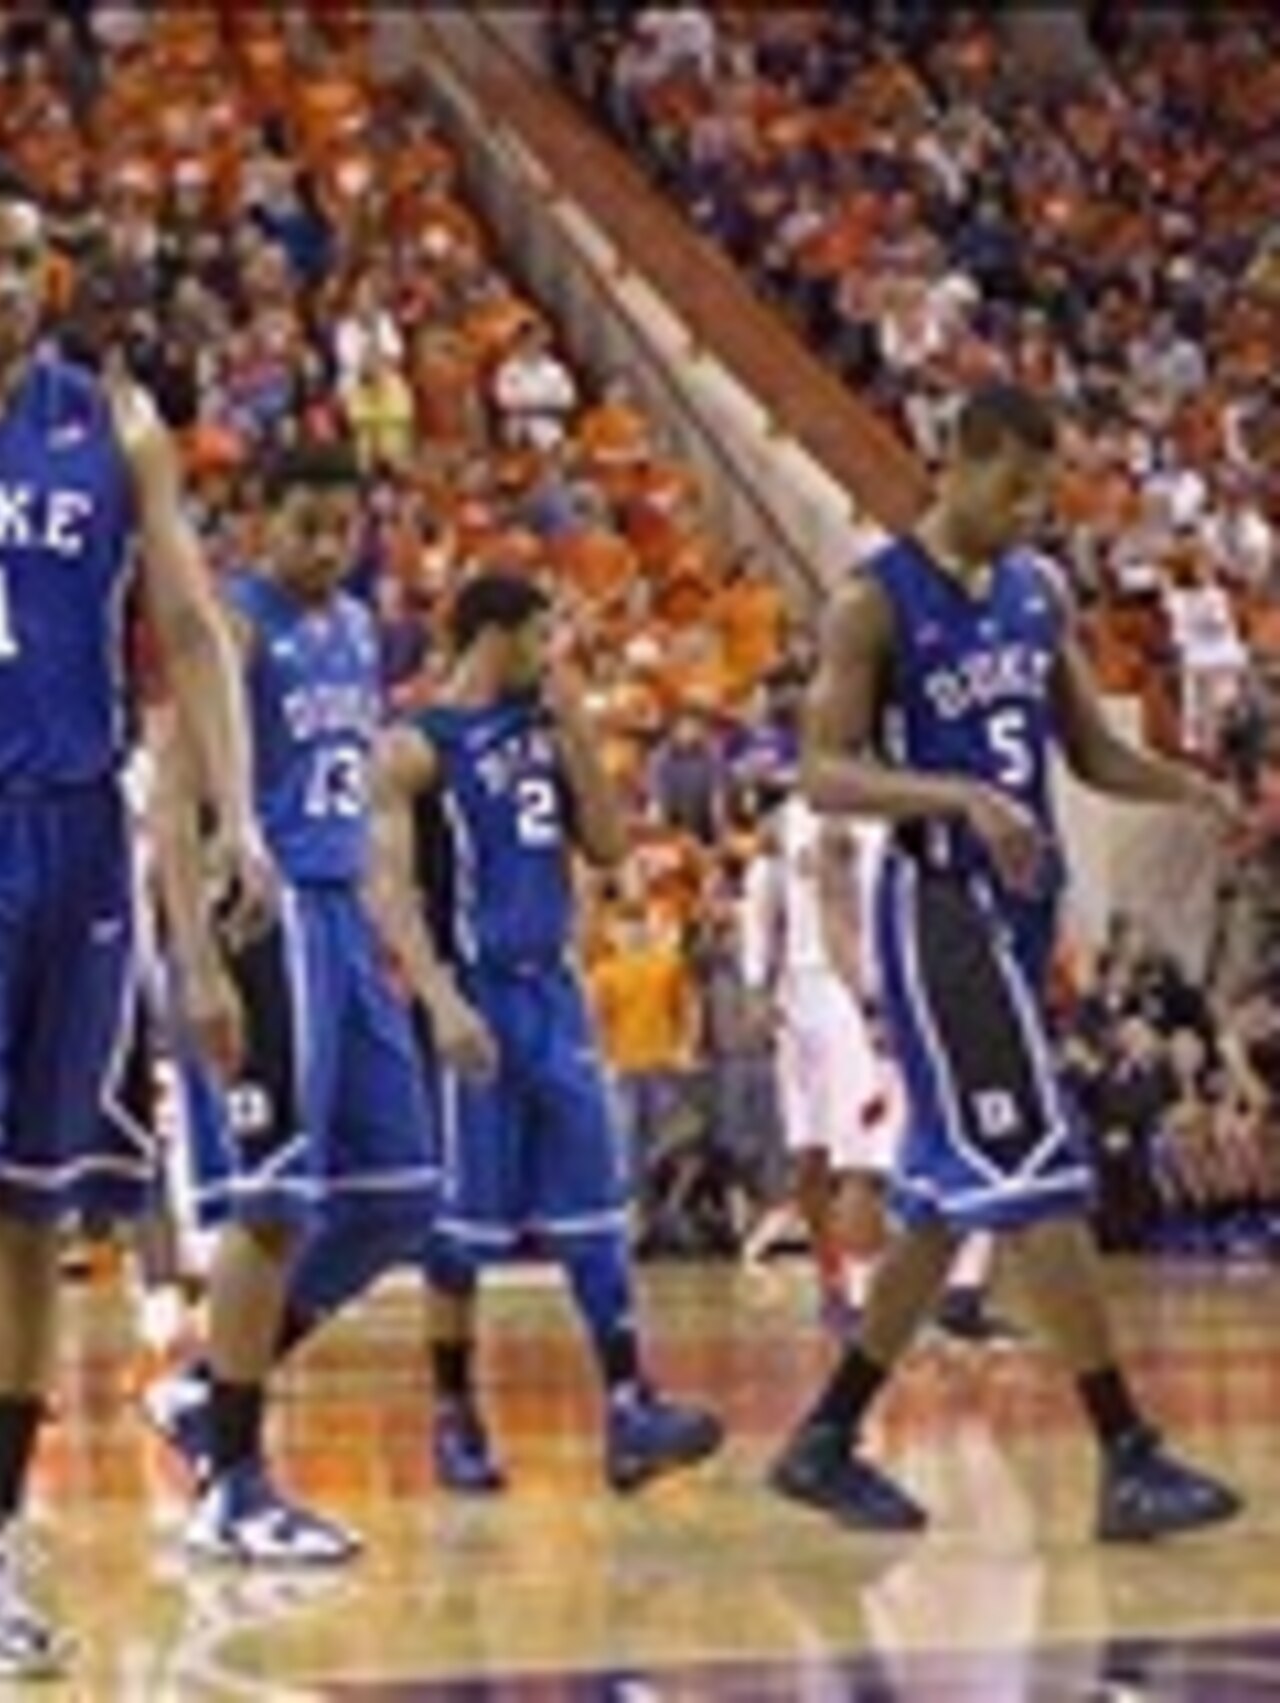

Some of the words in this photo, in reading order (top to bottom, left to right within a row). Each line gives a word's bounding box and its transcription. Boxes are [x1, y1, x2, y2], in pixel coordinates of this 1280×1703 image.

[987, 707, 1034, 785] 5
[303, 747, 362, 816] 13
[517, 779, 562, 846] 2
